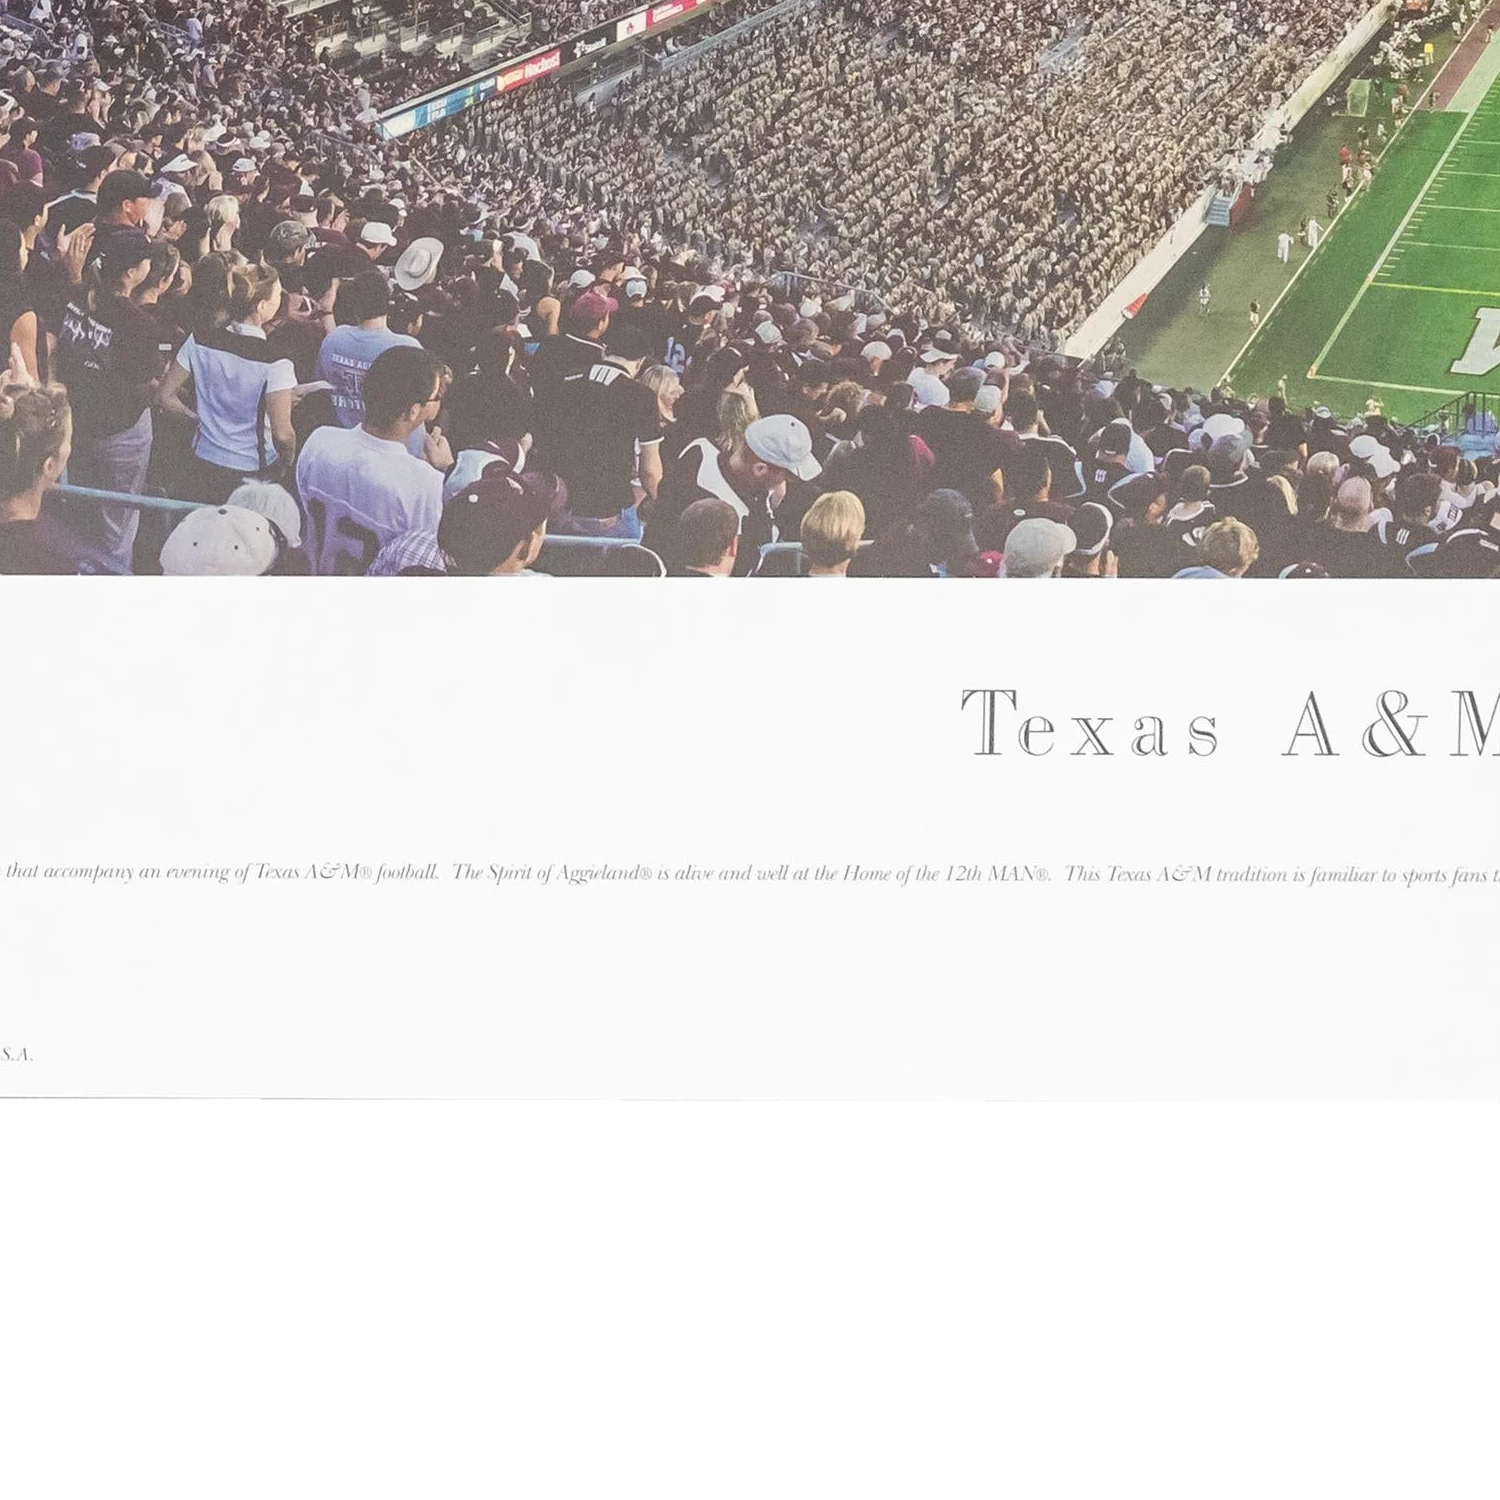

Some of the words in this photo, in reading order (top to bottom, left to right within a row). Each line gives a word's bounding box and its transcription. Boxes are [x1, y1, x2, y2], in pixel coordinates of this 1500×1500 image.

[961, 689, 1217, 757] Texas
[6, 862, 38, 878] that
[44, 864, 134, 884] accompany
[139, 868, 160, 879] an
[166, 863, 231, 884] evening
[235, 863, 253, 884] of
[256, 863, 300, 879] Texas
[373, 863, 439, 885] football.
[453, 863, 483, 880] The
[487, 863, 532, 886] Spirit
[537, 864, 555, 885] of
[658, 865, 669, 880] is
[675, 864, 715, 880] alive
[718, 864, 752, 880] and
[757, 865, 789, 880] well
[793, 868, 809, 881] at
[815, 865, 838, 881] the
[843, 865, 892, 881] Home
[896, 865, 915, 887] of
[916, 864, 940, 881] the
[946, 865, 981, 881] 12th
[1066, 865, 1100, 881] This
[1108, 865, 1152, 882] Texas
[1156, 865, 1212, 882] A&M
[1217, 866, 1287, 882] tradition
[1293, 866, 1306, 882] is
[1307, 866, 1378, 888] familiar
[1382, 869, 1396, 882] to
[1401, 868, 1447, 888] sports
[1448, 867, 1488, 888] fans
